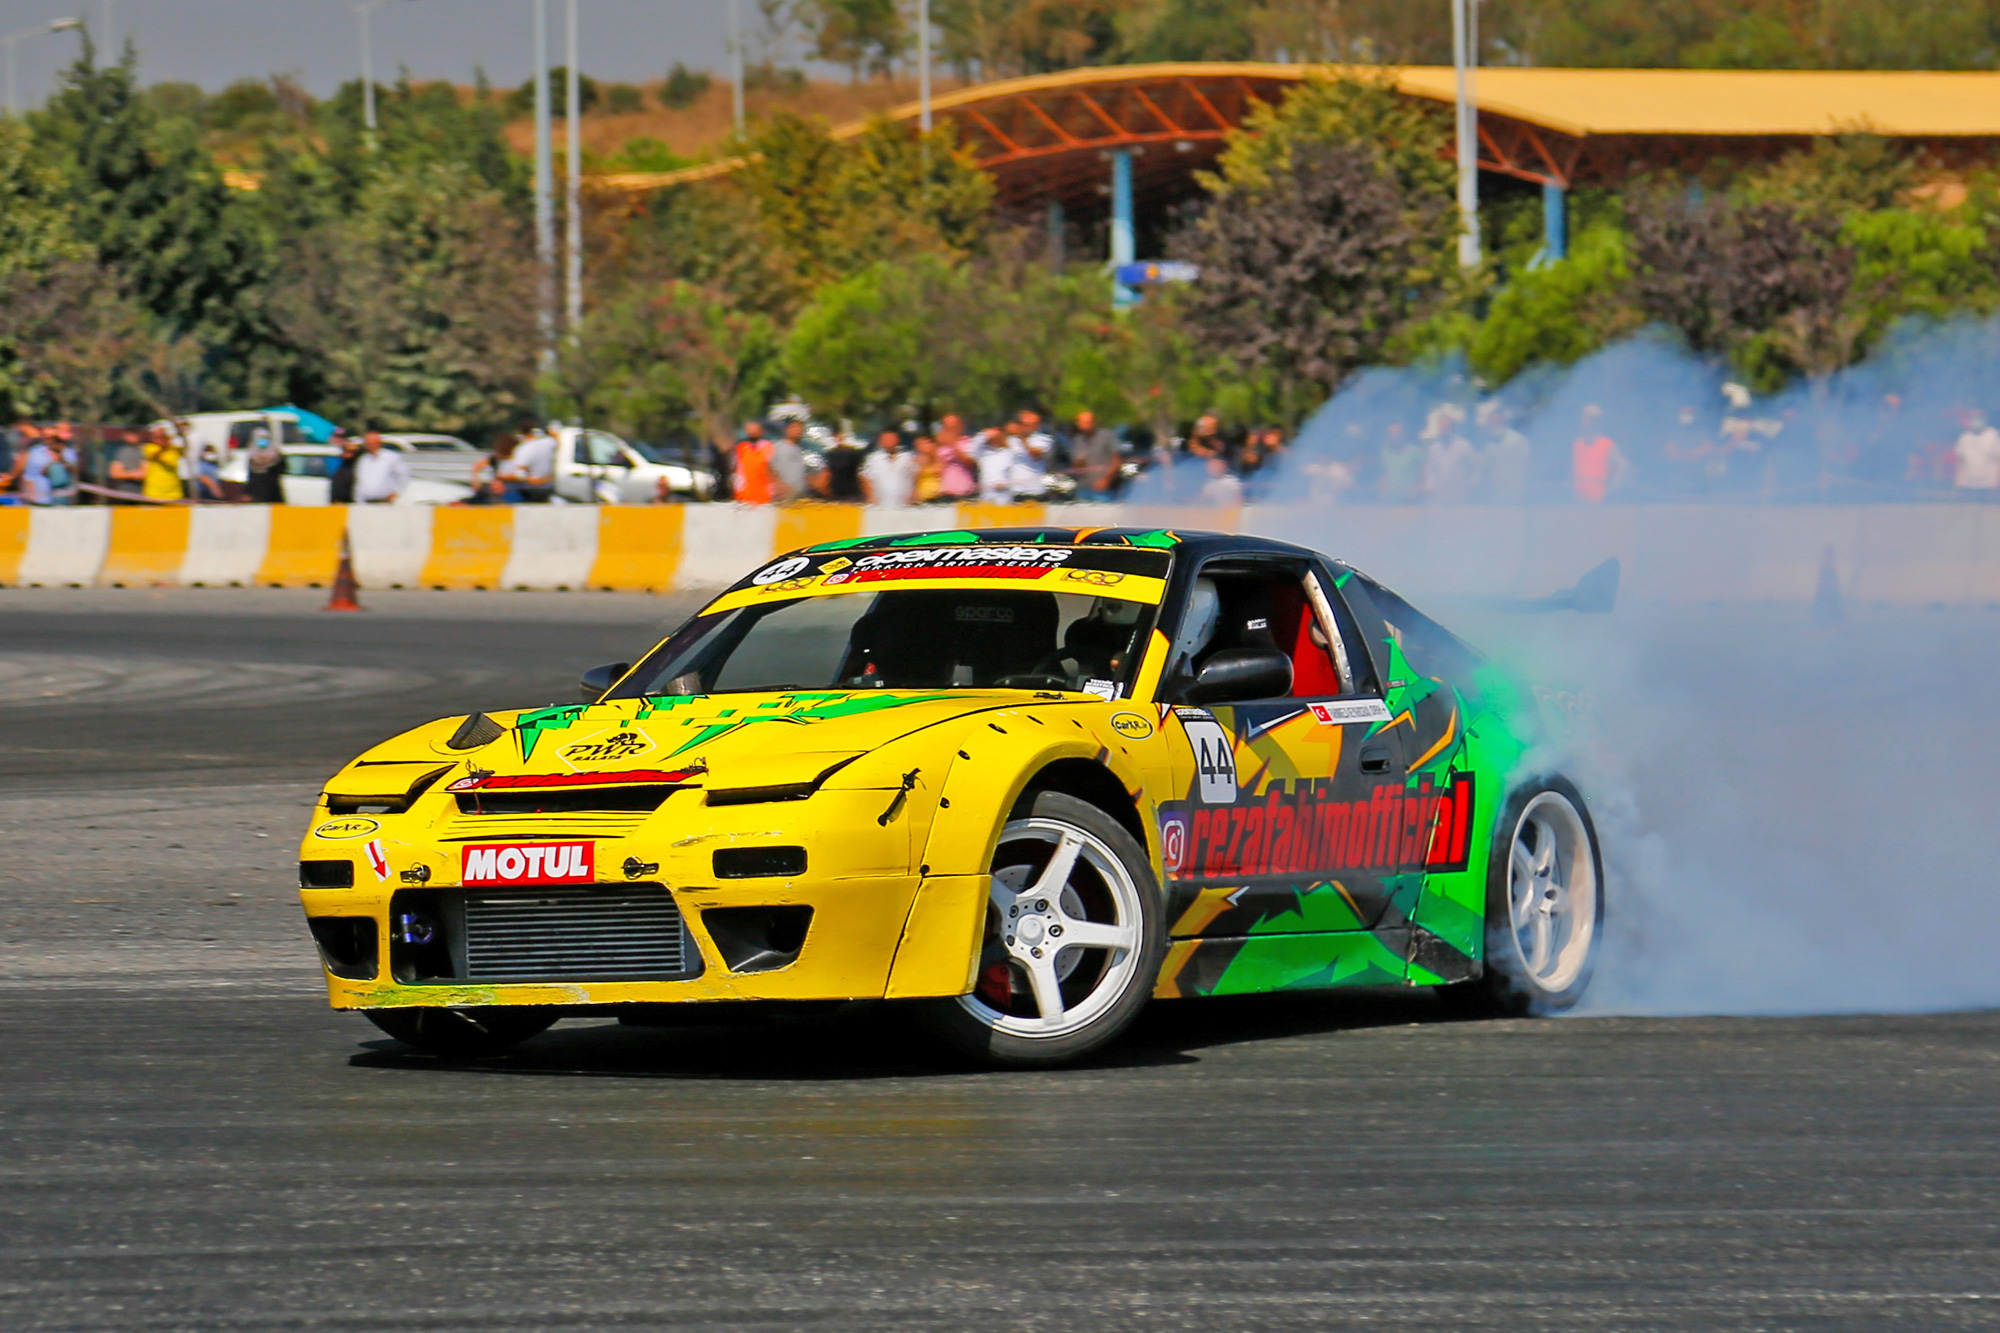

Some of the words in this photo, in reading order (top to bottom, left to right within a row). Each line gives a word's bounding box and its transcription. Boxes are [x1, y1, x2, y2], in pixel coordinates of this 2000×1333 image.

[760, 561, 803, 578] 44
[851, 562, 926, 574] TURKISH
[954, 606, 1015, 620] sparco
[565, 743, 647, 757] PWR
[1201, 738, 1234, 784] 44
[464, 845, 589, 881] MOTUL
